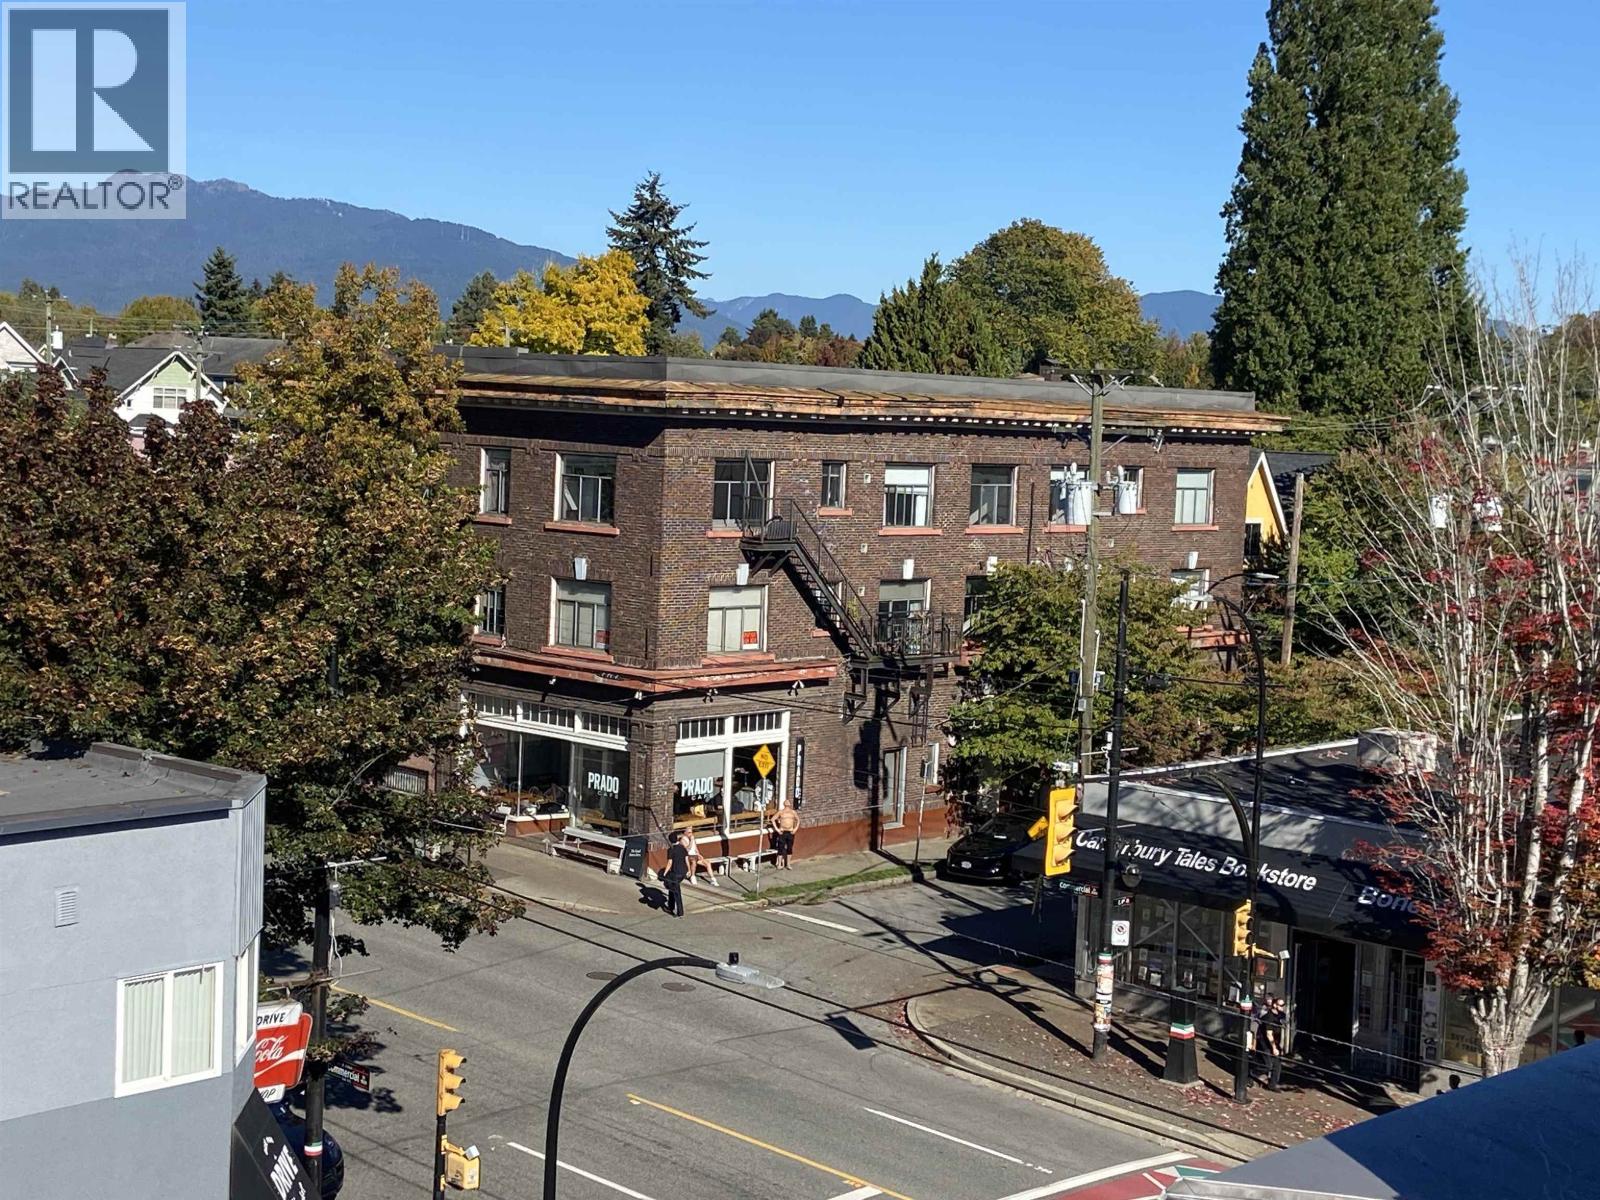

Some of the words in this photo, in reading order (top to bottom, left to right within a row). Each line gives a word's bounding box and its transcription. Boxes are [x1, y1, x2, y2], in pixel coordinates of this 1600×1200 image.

[588, 771, 619, 793] PRADO
[681, 776, 714, 797] PRADO
[1174, 848, 1218, 873] Tales
[1219, 856, 1317, 891] Bokstore
[256, 1012, 286, 1026] DRIVE
